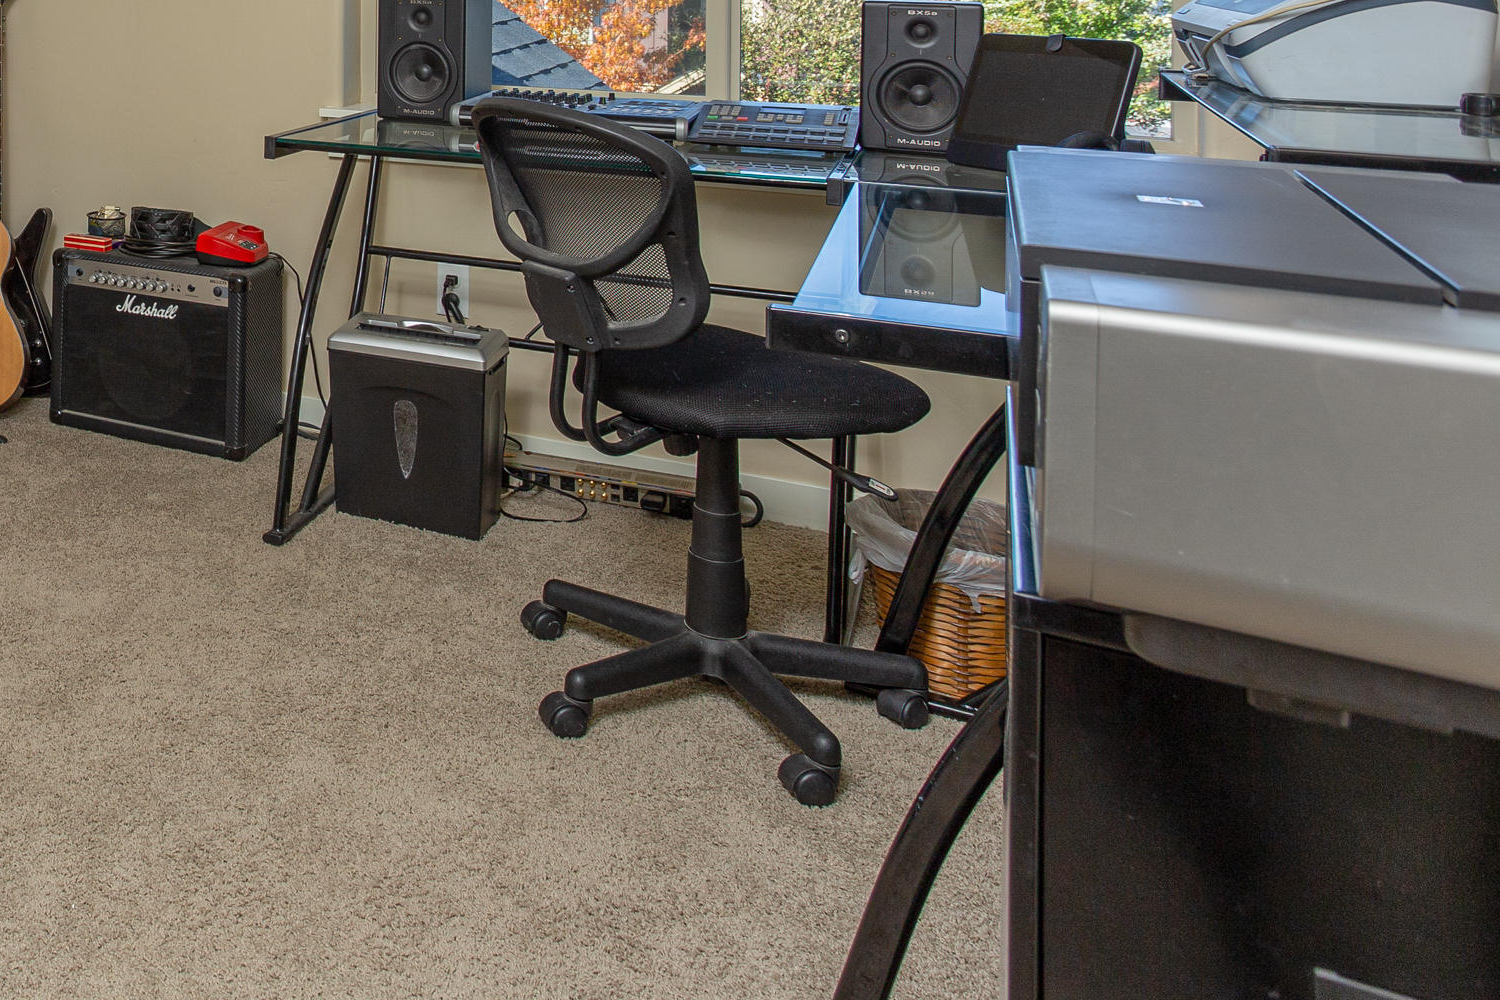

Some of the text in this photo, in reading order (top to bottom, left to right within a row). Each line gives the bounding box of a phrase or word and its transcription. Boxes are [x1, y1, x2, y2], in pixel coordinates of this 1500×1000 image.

[403, 108, 435, 116] M-AUDIO
[897, 138, 941, 147] M-AUDIO
[116, 294, 179, 320] Marshall
